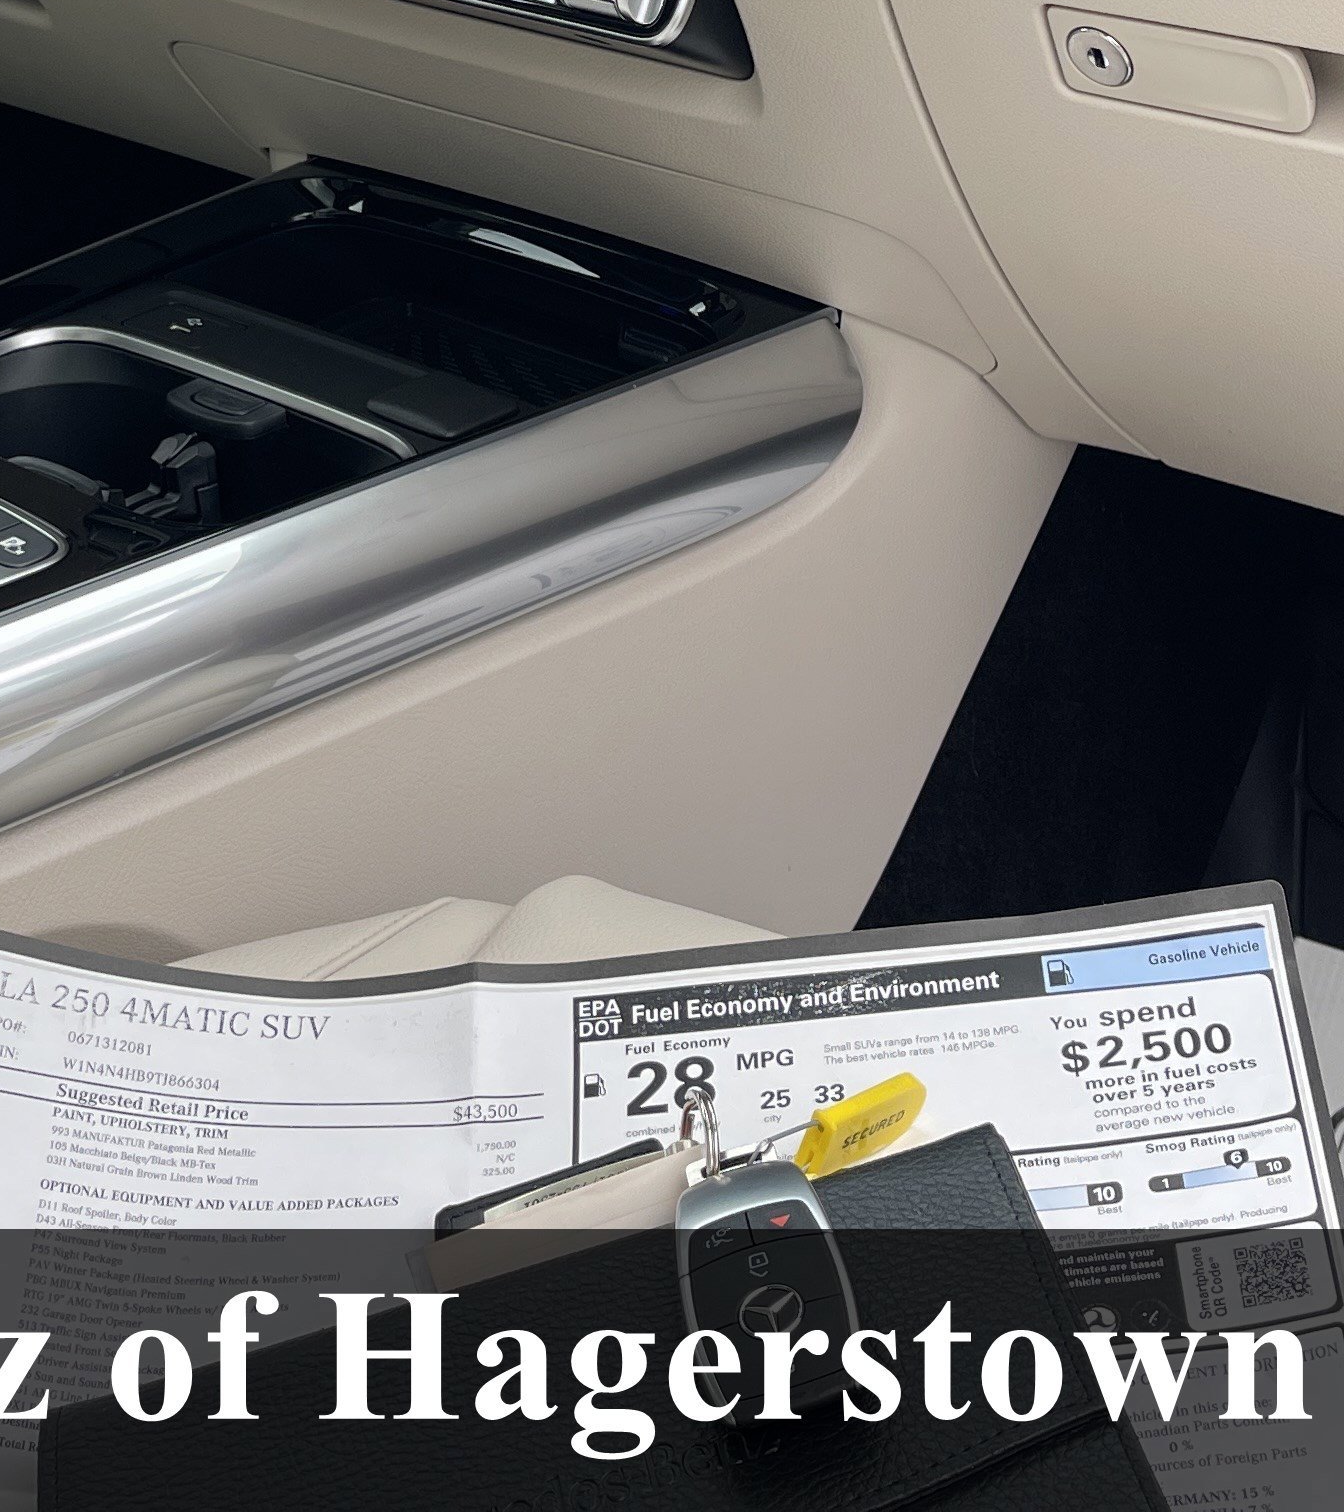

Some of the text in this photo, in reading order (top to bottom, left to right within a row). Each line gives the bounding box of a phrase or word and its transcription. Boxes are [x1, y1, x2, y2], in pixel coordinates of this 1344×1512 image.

[1148, 940, 1260, 966] Gasoline Vehicle
[578, 998, 620, 1017] EPA
[632, 970, 1000, 1025] Fuel Economy and Environment
[51, 985, 110, 1018] 250
[120, 996, 249, 1038] 4MATIC
[260, 1014, 330, 1041] SUV
[1050, 996, 1197, 1030] You spend
[578, 1020, 621, 1037] DOT
[68, 1030, 152, 1056] 0671312081
[625, 1036, 731, 1056] Fuel Economy
[1061, 1022, 1232, 1077] $2,500
[737, 1049, 794, 1071] MPG
[63, 1057, 220, 1091] W1N4N4HB9TJ866304
[1085, 1058, 1257, 1090] more in fuel costs
[627, 1055, 716, 1117] 28
[815, 1084, 845, 1104] 33
[1092, 1078, 1215, 1104] over 5 years
[56, 1083, 249, 1121] Suggested Retail Price
[760, 1089, 791, 1110] 25
[1094, 1094, 1206, 1119] compared to the
[52, 1107, 228, 1140] PAINT, UPHOLSTERY, TRIM
[453, 1104, 518, 1122] $43,500
[1096, 1112, 1183, 1134] average new
[842, 1110, 905, 1149] SECURED
[1146, 1140, 1186, 1154] Smog
[1191, 1134, 1235, 1148] Rating
[1018, 1156, 1060, 1168] Rating
[1231, 1151, 1242, 1164] 6
[1265, 1161, 1283, 1172] 10
[1162, 1179, 1169, 1188] 1
[1267, 1175, 1292, 1186] Best
[40, 1178, 399, 1211] OPTIONAL EQUIPMENT AND VALUE ADDED PACKAGES
[1092, 1187, 1115, 1202] 10
[1098, 1205, 1123, 1215] Best
